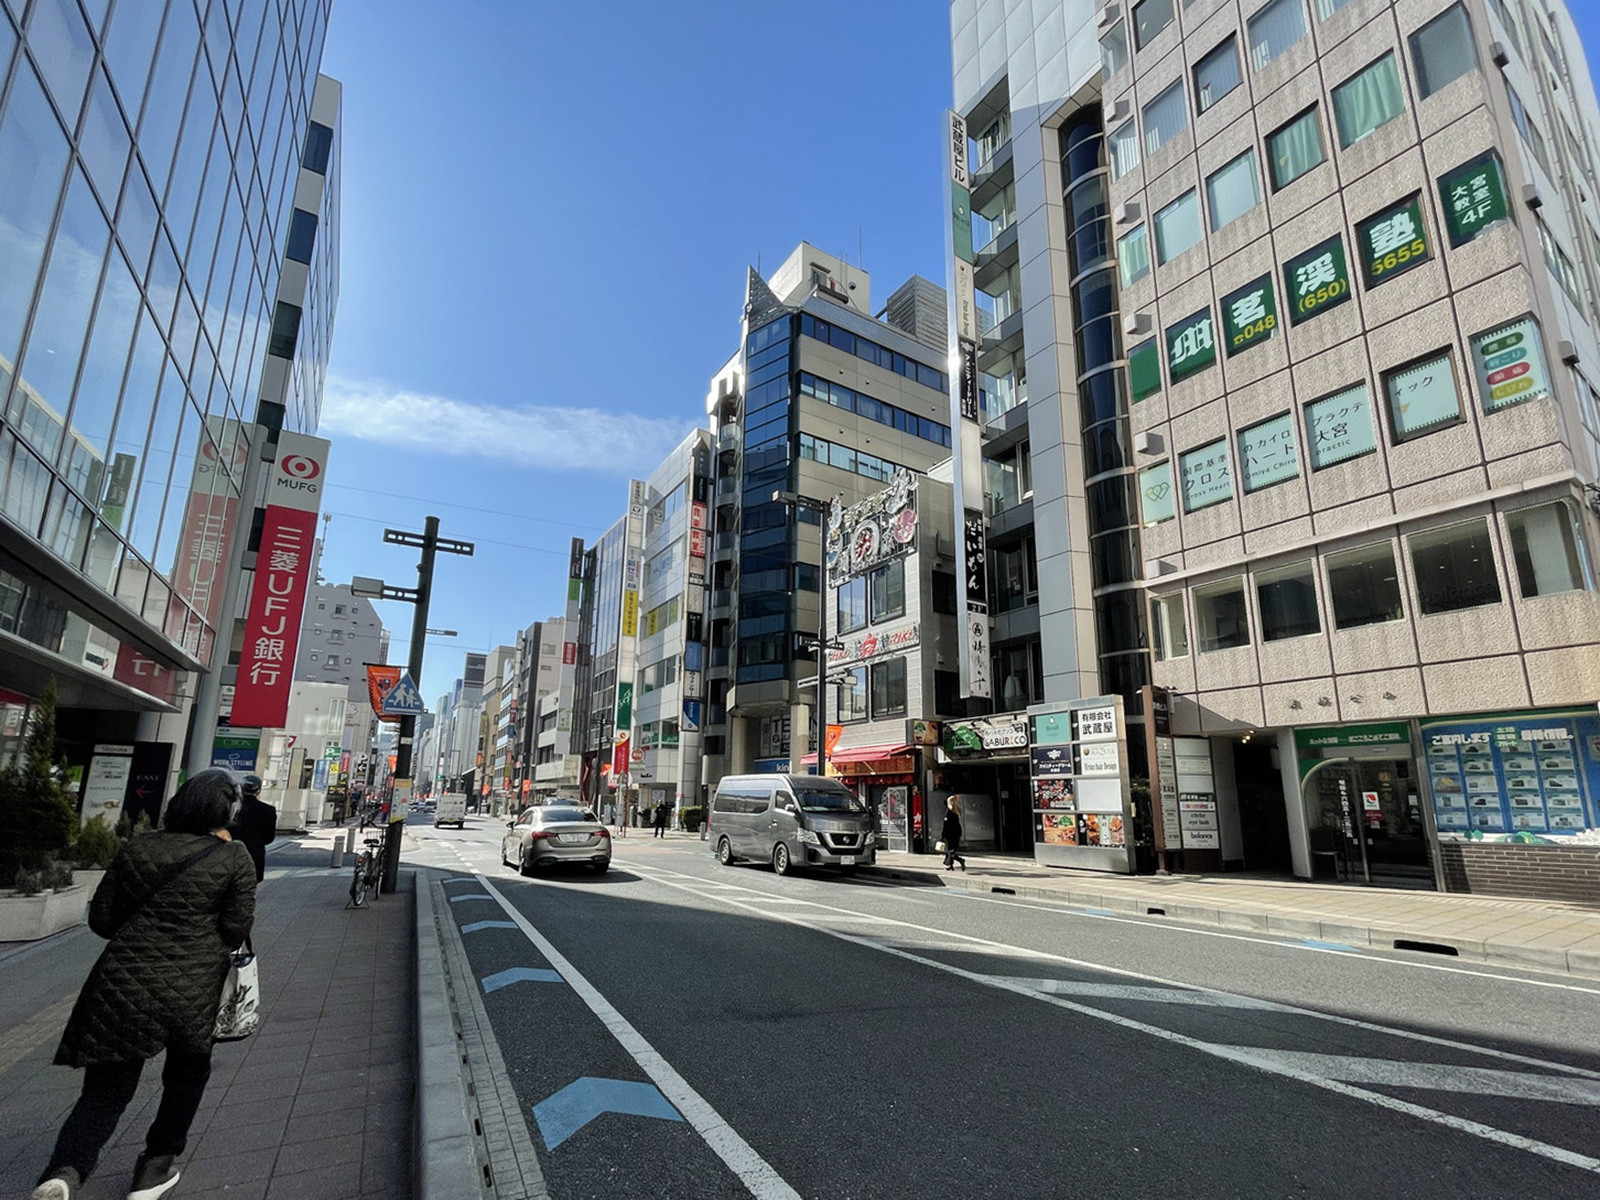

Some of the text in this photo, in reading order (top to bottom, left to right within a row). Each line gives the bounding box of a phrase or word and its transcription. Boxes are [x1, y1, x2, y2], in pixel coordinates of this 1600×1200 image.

[1461, 201, 1492, 225] 4F
[1244, 238, 1425, 340] 048 (650) 5655
[1184, 422, 1348, 492] クロス ハート 大宮
[1208, 482, 1230, 493] Heart
[1245, 466, 1271, 480] Omiya
[1272, 458, 1297, 470] Chiro
[1315, 438, 1351, 456] practic
[277, 477, 317, 494] MUFG
[250, 525, 303, 688] 三菱UFJ銀行
[1081, 711, 1112, 722] 有限会社
[1082, 722, 1114, 735] 武蔵屋
[984, 734, 1027, 747] GABURICO
[1431, 732, 1492, 746] ご案内します
